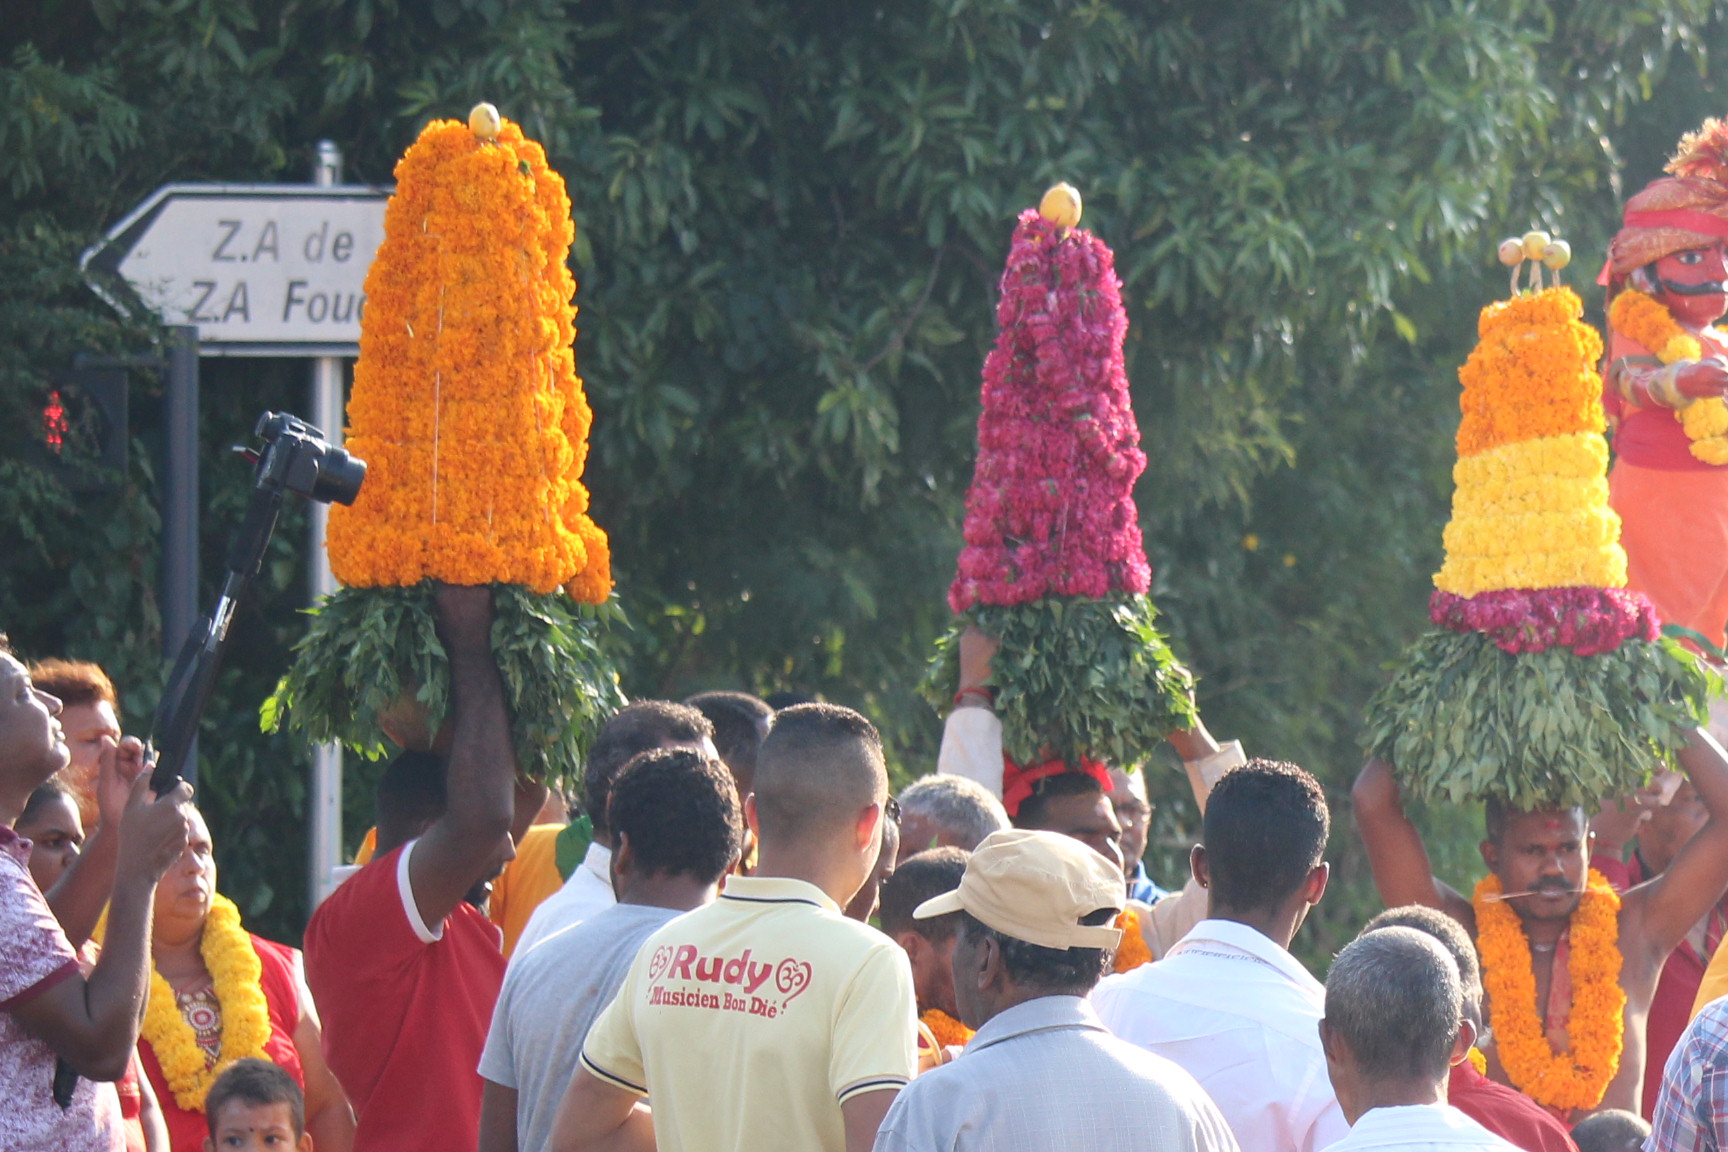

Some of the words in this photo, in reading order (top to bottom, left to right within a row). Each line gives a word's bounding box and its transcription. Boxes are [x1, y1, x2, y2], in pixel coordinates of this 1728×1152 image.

[212, 220, 279, 262] Z.A
[303, 220, 353, 263] de
[189, 280, 250, 323] Z.A
[667, 944, 773, 995] Rudy
[650, 985, 720, 1010] Musicien
[723, 993, 746, 1012] Bon
[748, 997, 777, 1019] Dié
